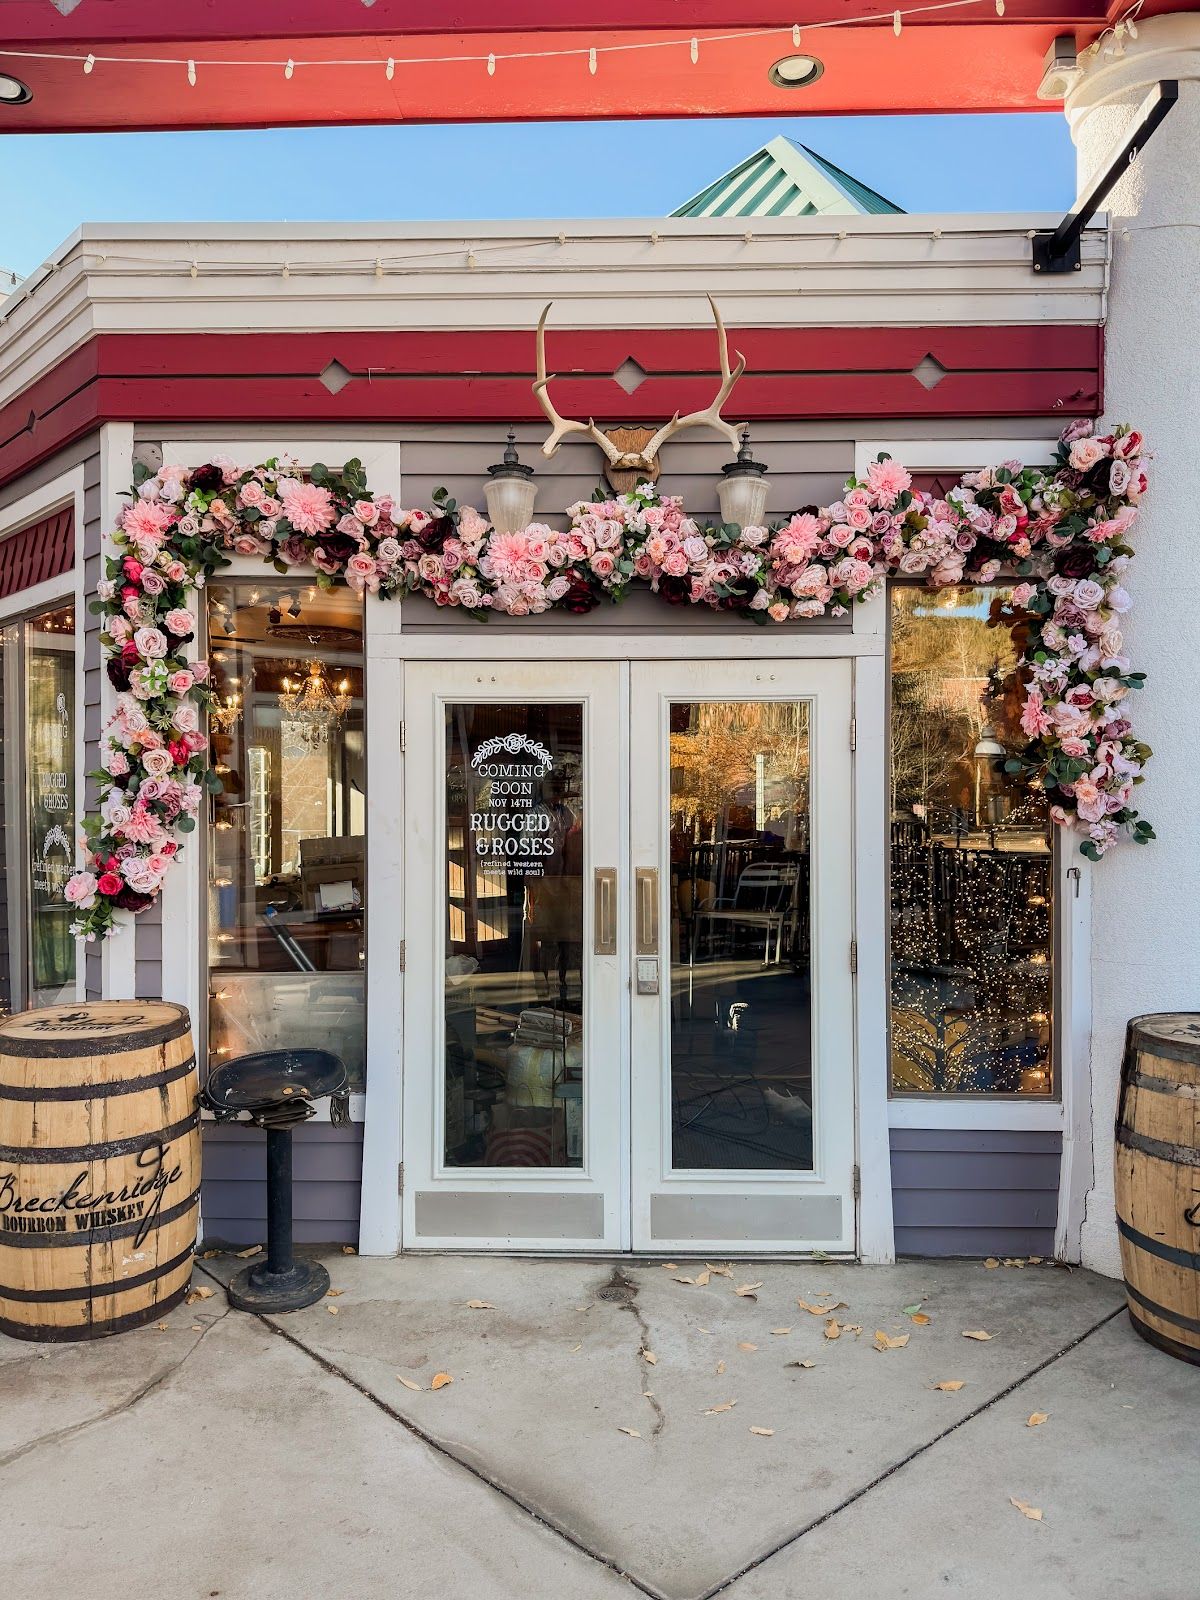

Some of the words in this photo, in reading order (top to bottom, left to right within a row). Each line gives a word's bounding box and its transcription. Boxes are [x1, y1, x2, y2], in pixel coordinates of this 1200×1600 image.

[478, 764, 545, 777] COMING
[491, 783, 533, 795] SOON
[489, 799, 507, 807] NOV
[511, 799, 532, 808] 14TH
[470, 814, 550, 831] RUGGED
[3, 1213, 67, 1232] BOURBON
[74, 1200, 144, 1230] WHISKEY
